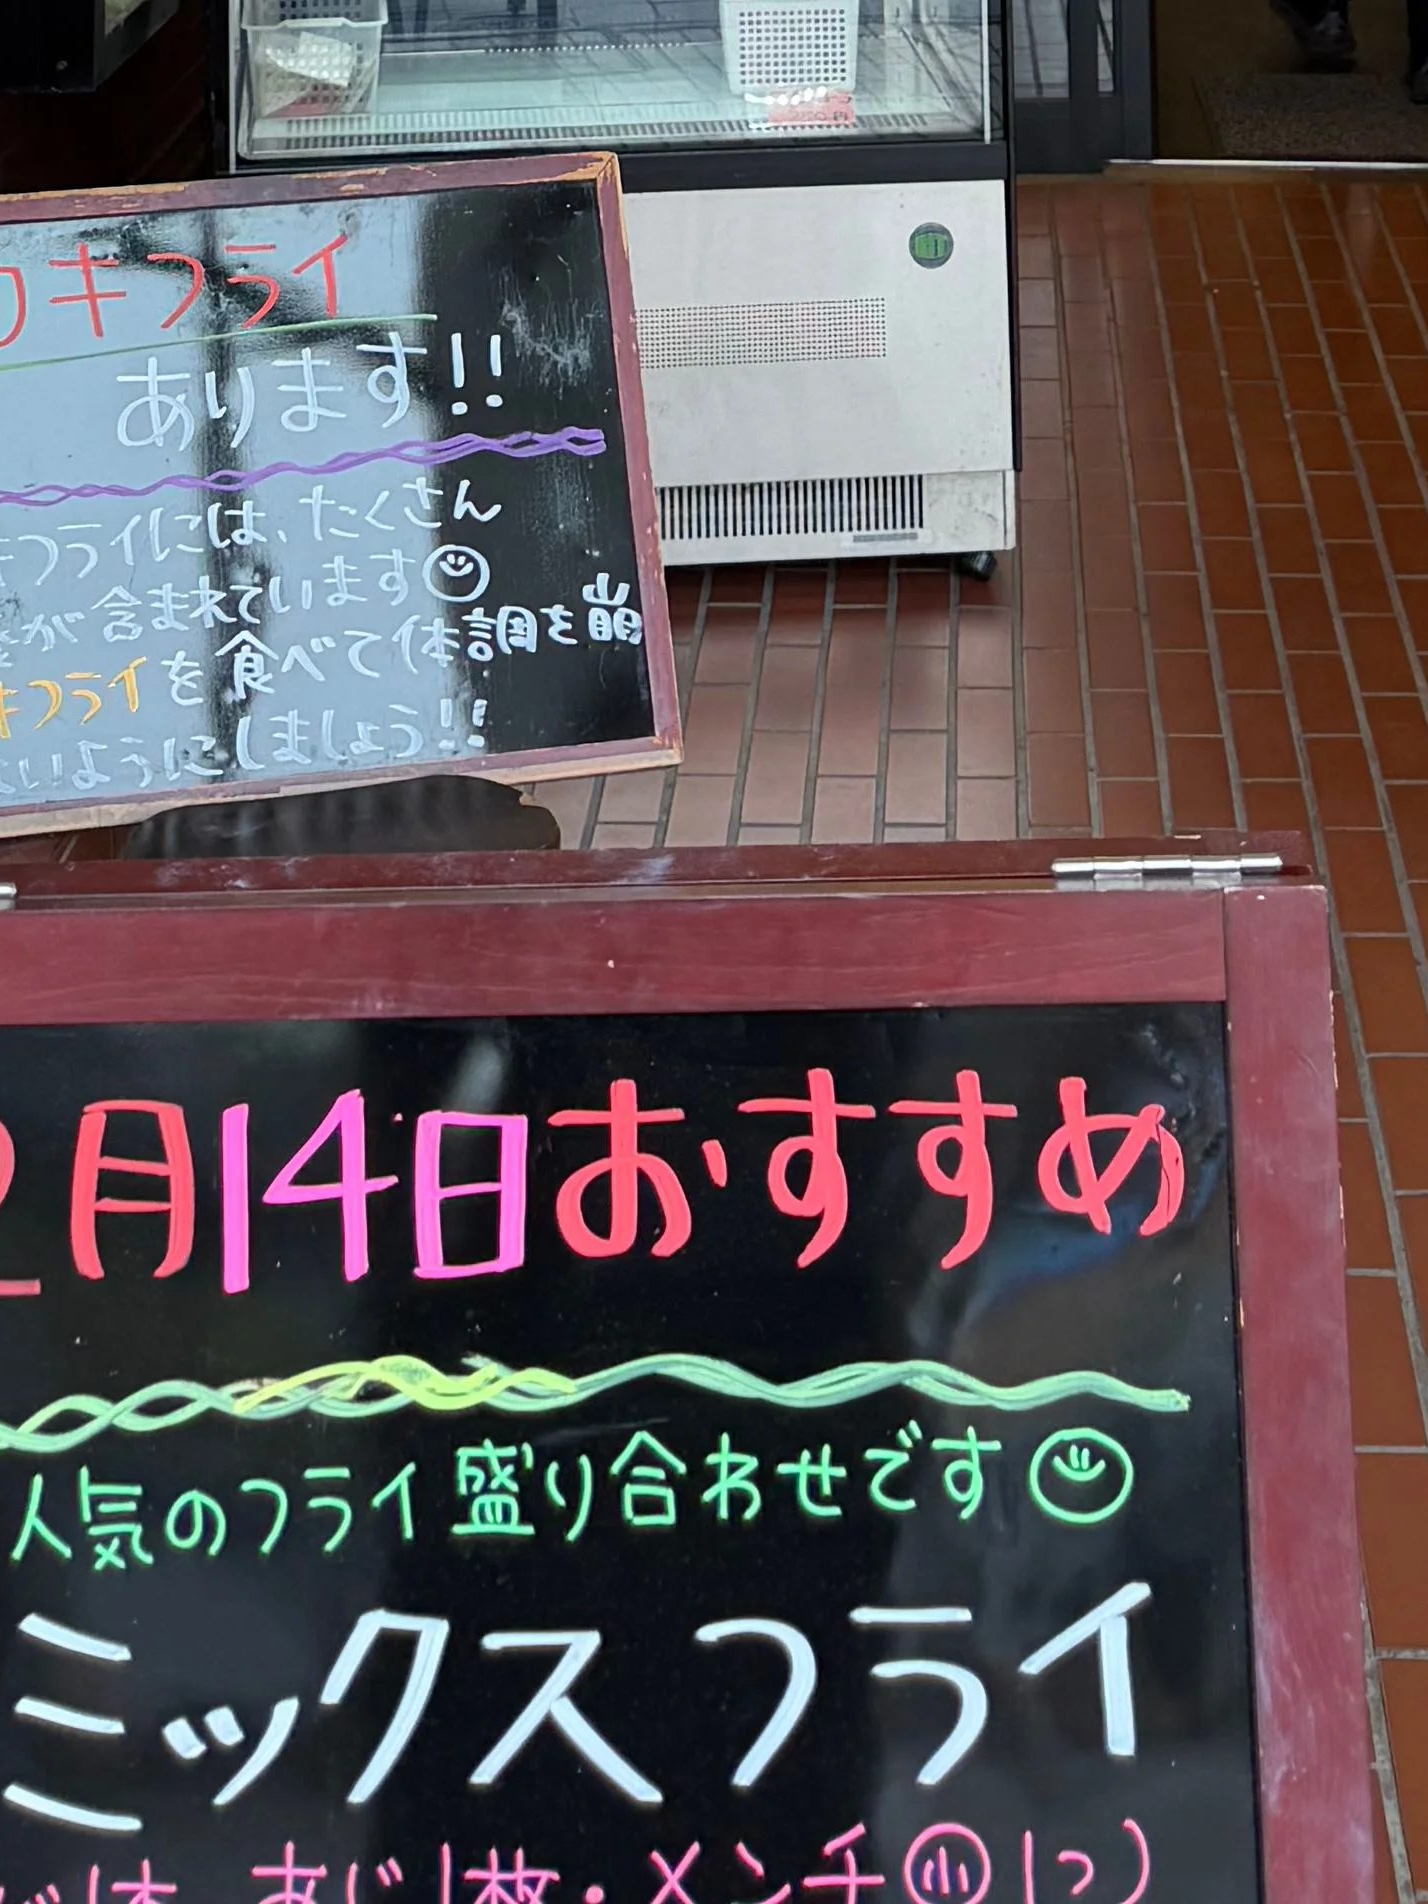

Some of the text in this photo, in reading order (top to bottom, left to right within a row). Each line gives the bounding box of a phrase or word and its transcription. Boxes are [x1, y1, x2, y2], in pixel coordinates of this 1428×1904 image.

[9, 1421, 1004, 1573] 人気のフライ盛り合わせです
[2, 1580, 1156, 1835] ミックスフライ
